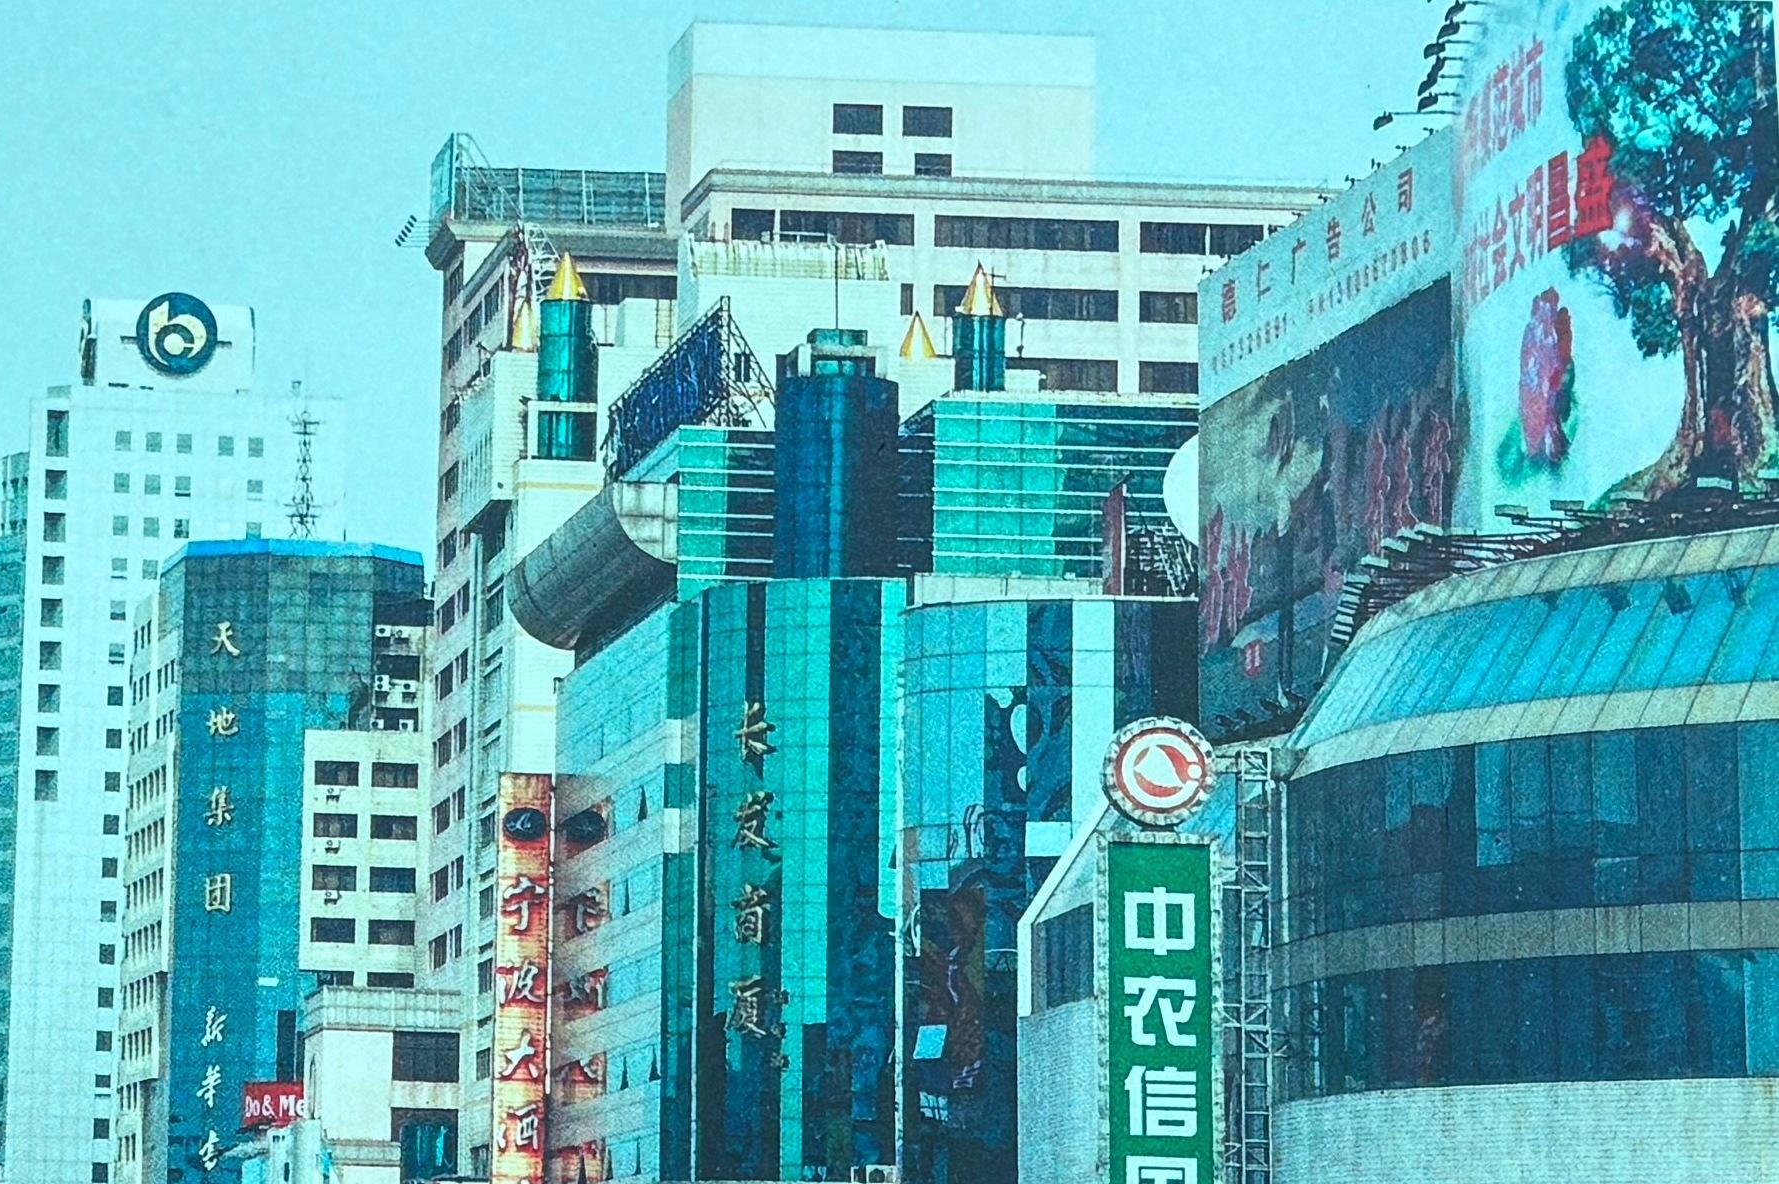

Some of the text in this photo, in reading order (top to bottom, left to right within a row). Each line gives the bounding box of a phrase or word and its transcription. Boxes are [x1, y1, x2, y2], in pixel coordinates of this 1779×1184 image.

[202, 620, 241, 915] 天地集团
[727, 700, 777, 1041] 长发商厦
